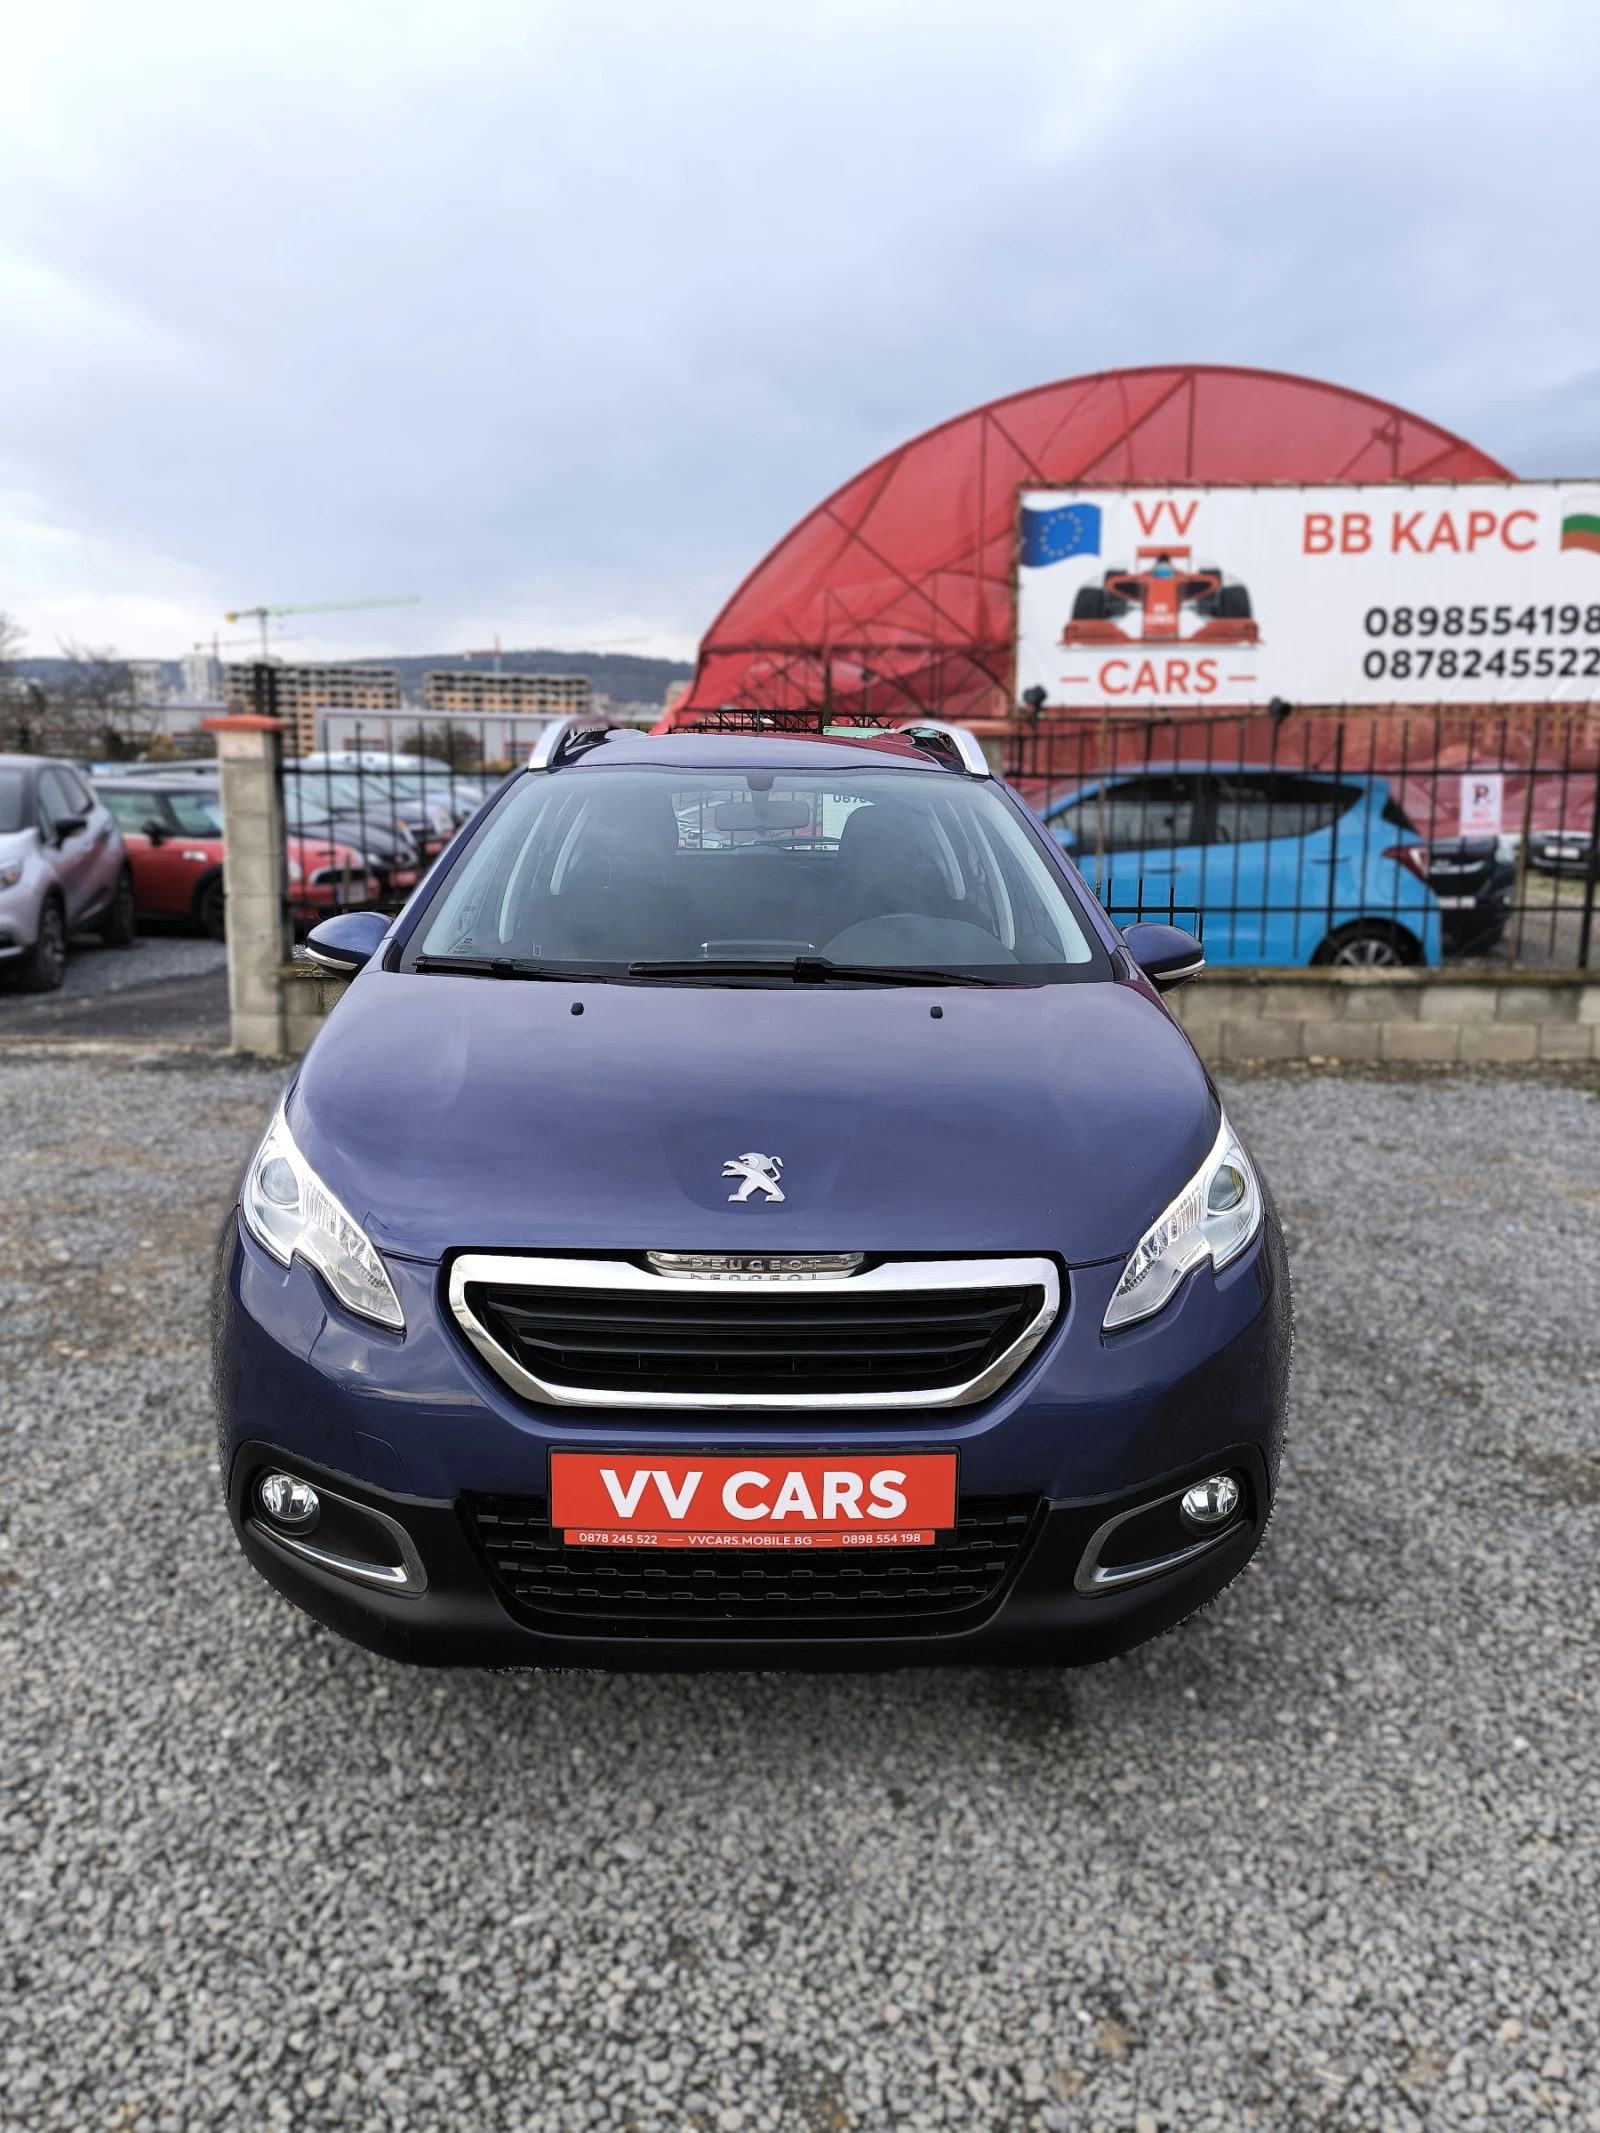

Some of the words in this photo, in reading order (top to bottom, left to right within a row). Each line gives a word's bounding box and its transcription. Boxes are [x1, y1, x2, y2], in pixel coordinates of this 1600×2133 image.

[1134, 500, 1198, 536] VV
[1303, 512, 1373, 555] ВВ
[1390, 508, 1540, 554] КАРС
[1364, 604, 1600, 638] 0898554198
[1098, 659, 1218, 694] CARS
[1363, 647, 1600, 680] 0878245522
[691, 1258, 821, 1272] PEUGEOT
[599, 1469, 704, 1519] VV
[721, 1469, 908, 1521] CARS
[579, 1532, 609, 1543] 0878
[612, 1534, 634, 1544] 245
[636, 1534, 658, 1545] 522
[688, 1535, 812, 1546] VVCARS.MOBILE.BG
[842, 1534, 873, 1545] 0898
[876, 1533, 898, 1544] 554
[901, 1532, 921, 1543] 198
